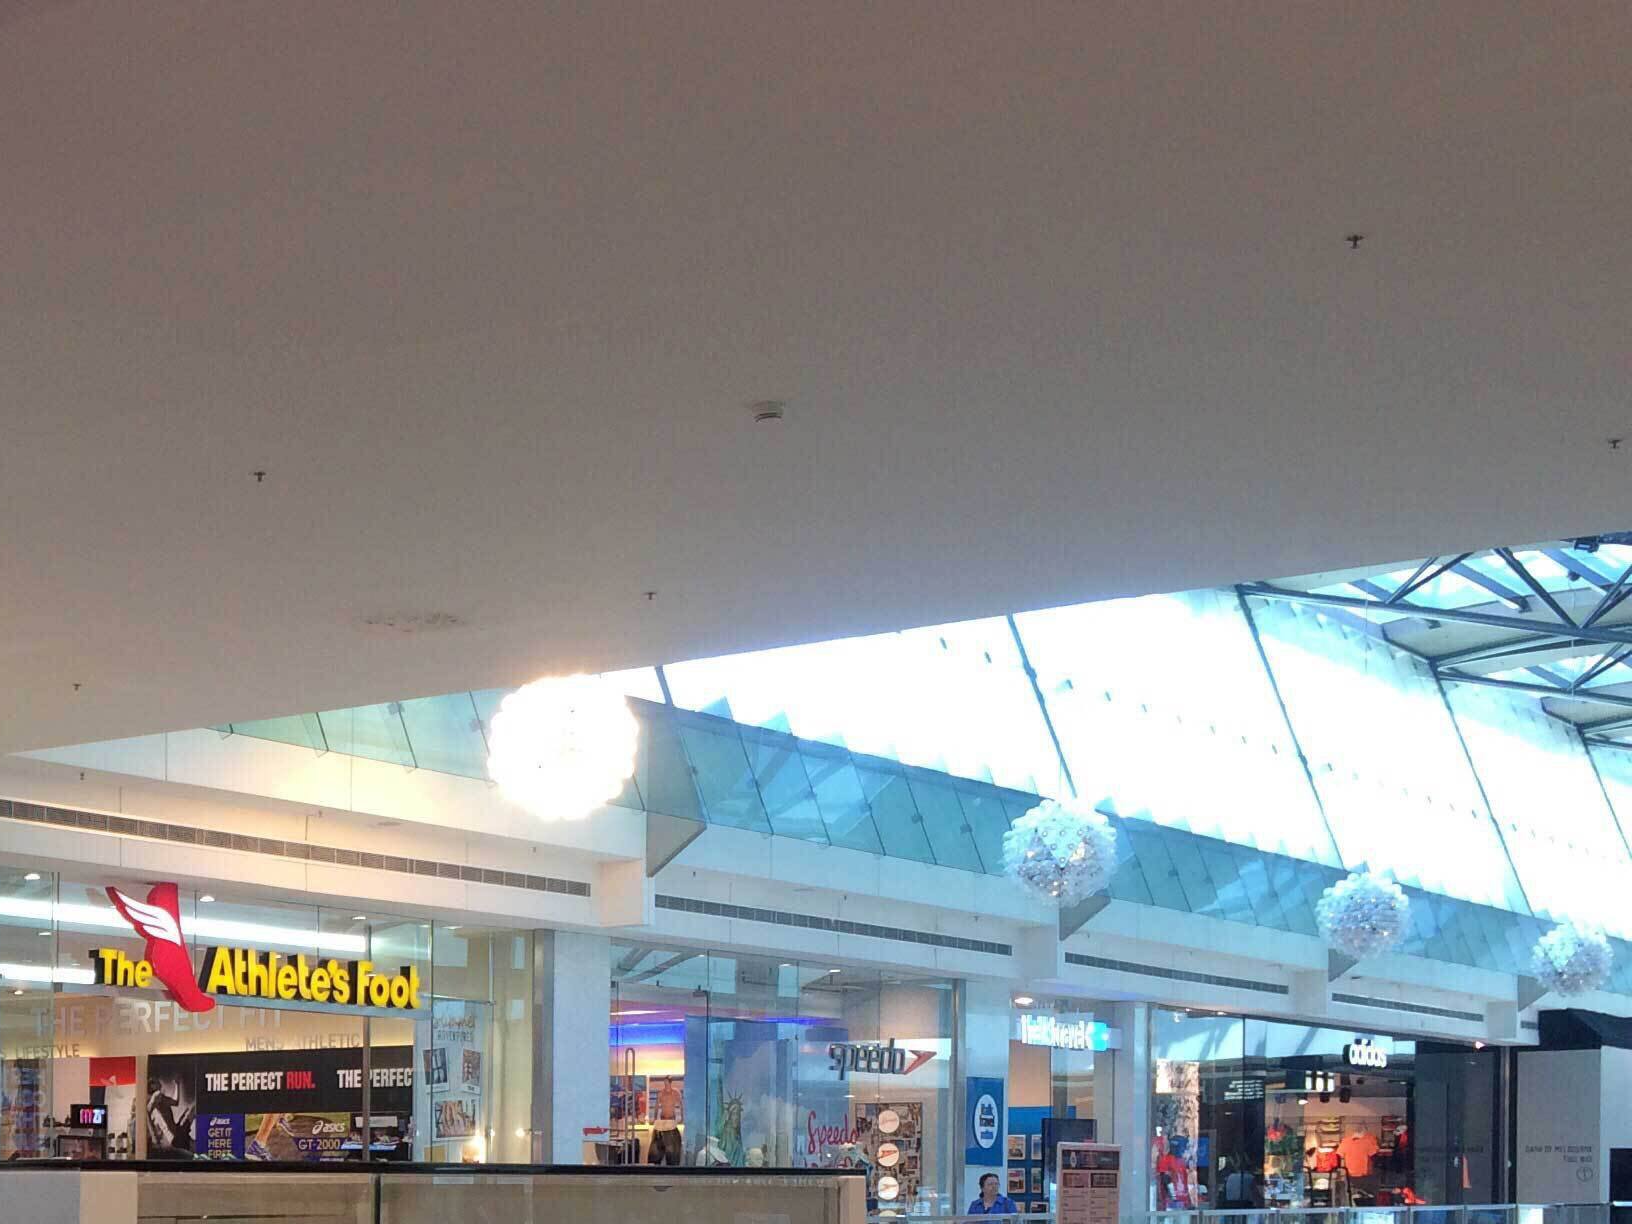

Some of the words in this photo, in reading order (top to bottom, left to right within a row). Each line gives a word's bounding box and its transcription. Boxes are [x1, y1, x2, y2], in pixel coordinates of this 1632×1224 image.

[96, 947, 154, 988] The
[206, 945, 350, 1007] Athlete's
[357, 960, 421, 1009] Foot
[16, 1043, 81, 1058] LIFESTYLE
[828, 1037, 906, 1081] speedo
[1347, 1039, 1388, 1069] adidas
[205, 1073, 229, 1092] THE
[231, 1071, 283, 1091] PERFECT
[286, 1071, 316, 1089] RUN.
[336, 1069, 361, 1089] THE
[369, 1067, 413, 1088] PERFEC
[321, 1122, 345, 1134] asics
[807, 1110, 860, 1161] Speedo
[208, 1139, 232, 1149] HERE
[298, 1138, 340, 1151] GT-2000
